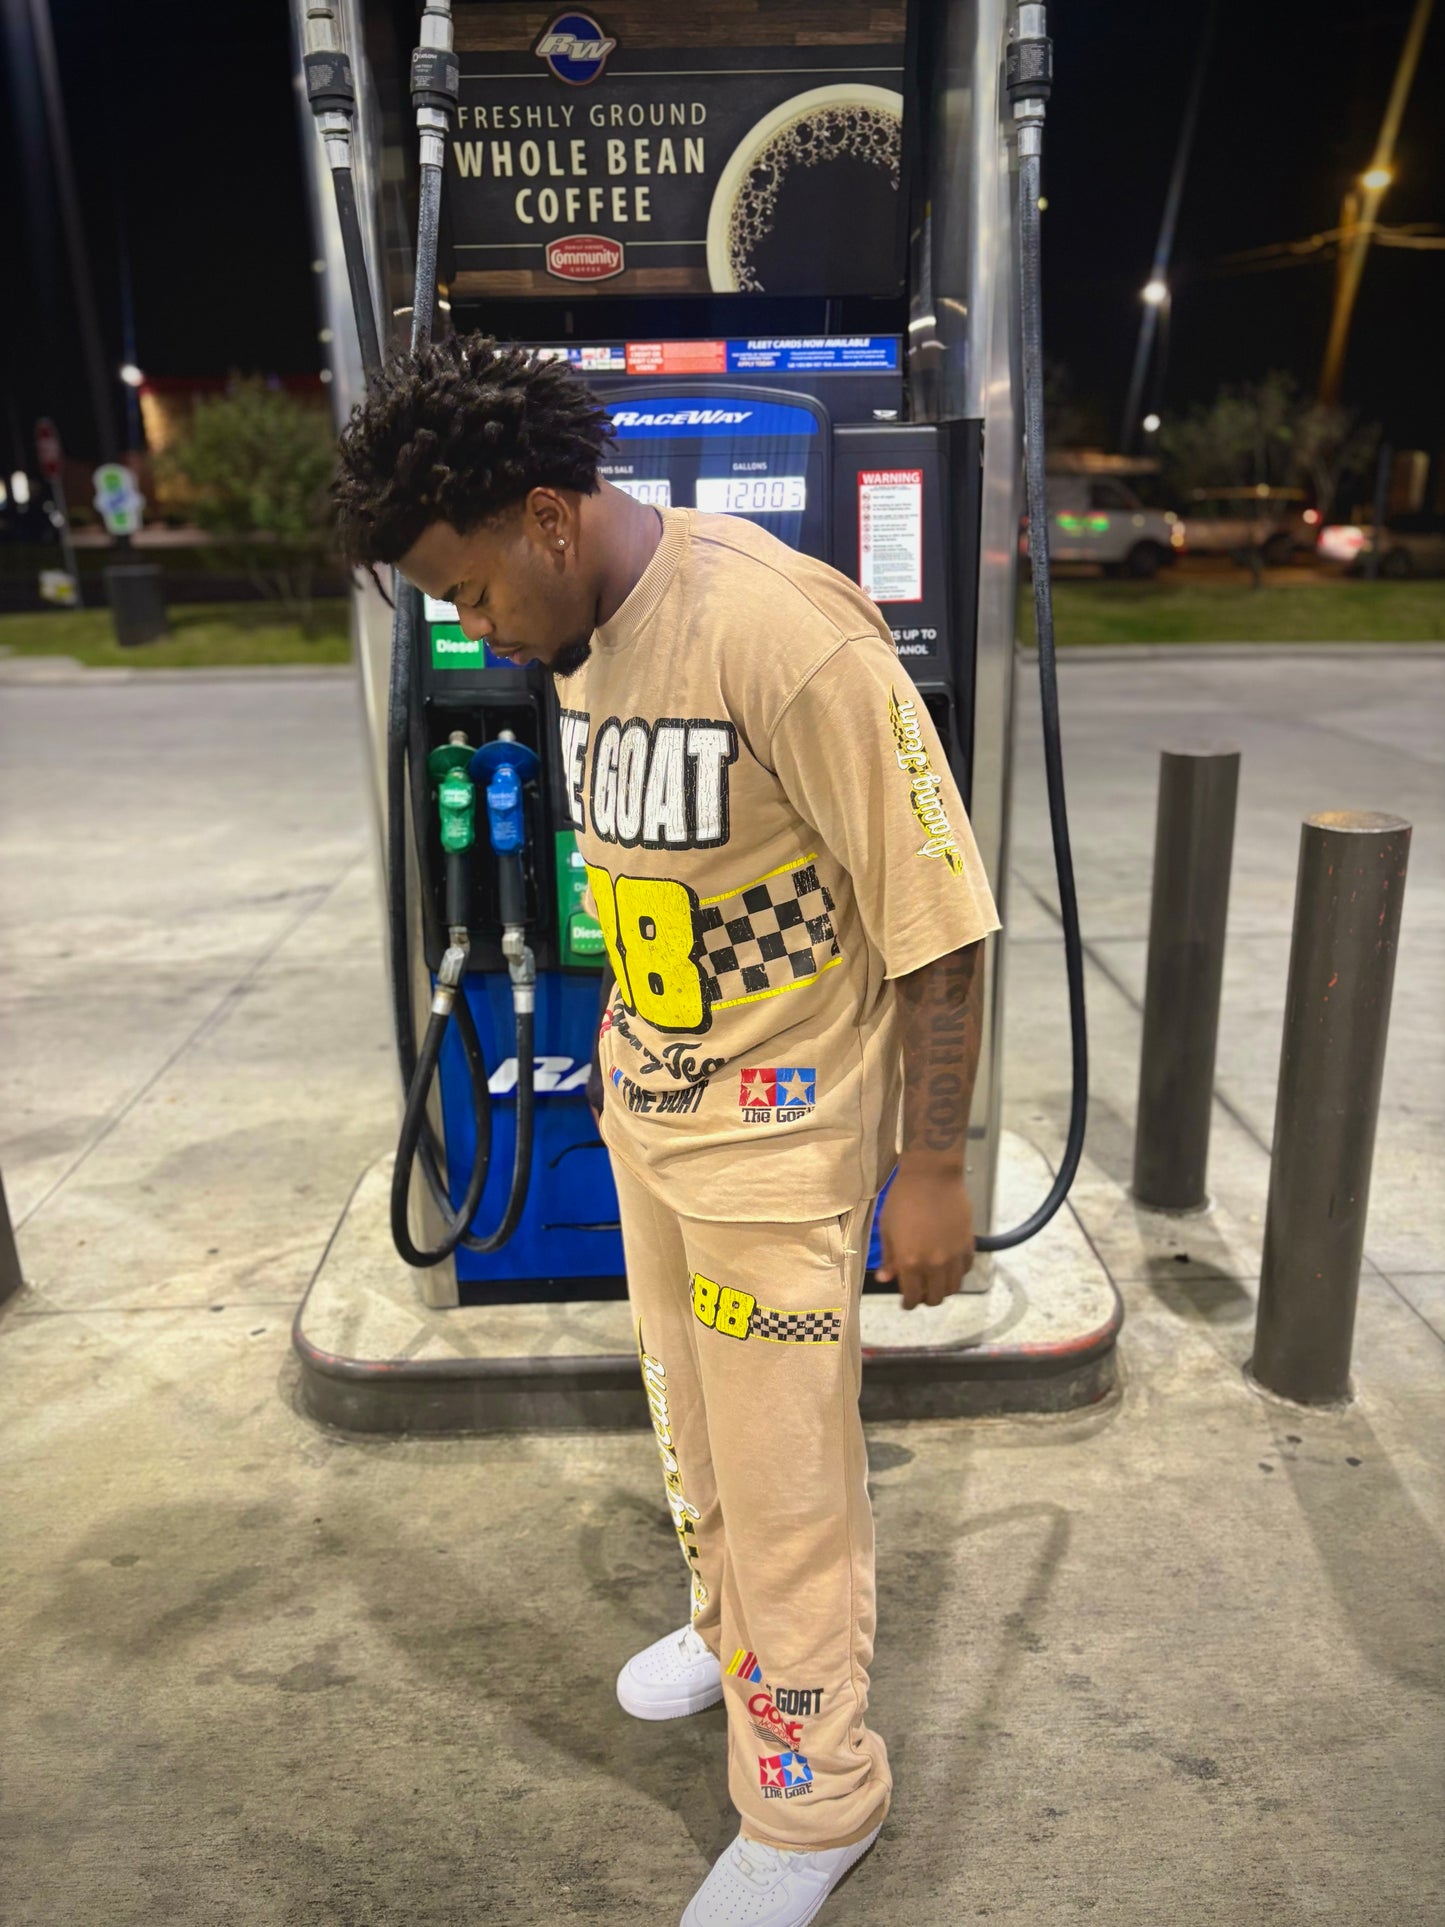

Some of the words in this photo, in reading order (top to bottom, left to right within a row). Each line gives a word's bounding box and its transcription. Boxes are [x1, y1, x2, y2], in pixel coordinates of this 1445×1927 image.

[457, 105, 575, 129] FRESHLY
[589, 103, 707, 127] GROUND
[453, 139, 588, 178] WHOLE
[607, 137, 705, 175] BEAN
[515, 186, 651, 224] COFFEE
[550, 249, 619, 269] Community
[802, 339, 825, 348] NOW
[597, 466, 614, 474] THIS
[615, 465, 634, 474] SALE
[733, 462, 768, 471] GALLONS
[862, 471, 920, 485] WARNING
[903, 629, 920, 640] UP
[920, 628, 937, 640] TO
[436, 639, 480, 653] Diesel
[895, 701, 928, 770] Team
[591, 716, 739, 850] GOAT
[623, 1076, 657, 1113] THE
[742, 1107, 771, 1123] The
[924, 1072, 962, 1151] GOD
[694, 1273, 757, 1341] 88
[776, 1688, 824, 1716] GOAT
[761, 1785, 783, 1799] The
[784, 1782, 813, 1799] Goat
